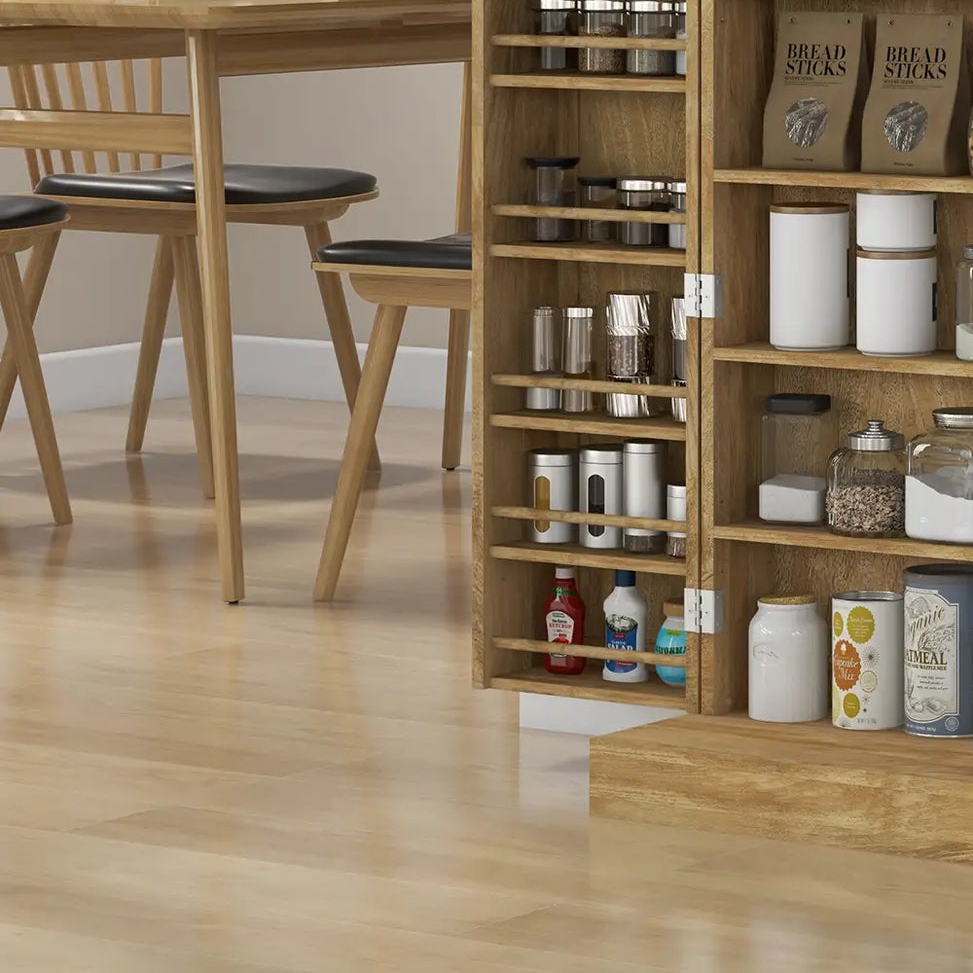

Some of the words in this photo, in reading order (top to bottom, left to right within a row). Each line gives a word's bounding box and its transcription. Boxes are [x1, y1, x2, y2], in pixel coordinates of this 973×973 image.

[787, 44, 846, 60] BREAD
[886, 46, 946, 62] BREAD
[785, 60, 847, 77] STICKS
[884, 62, 947, 80] STICKS
